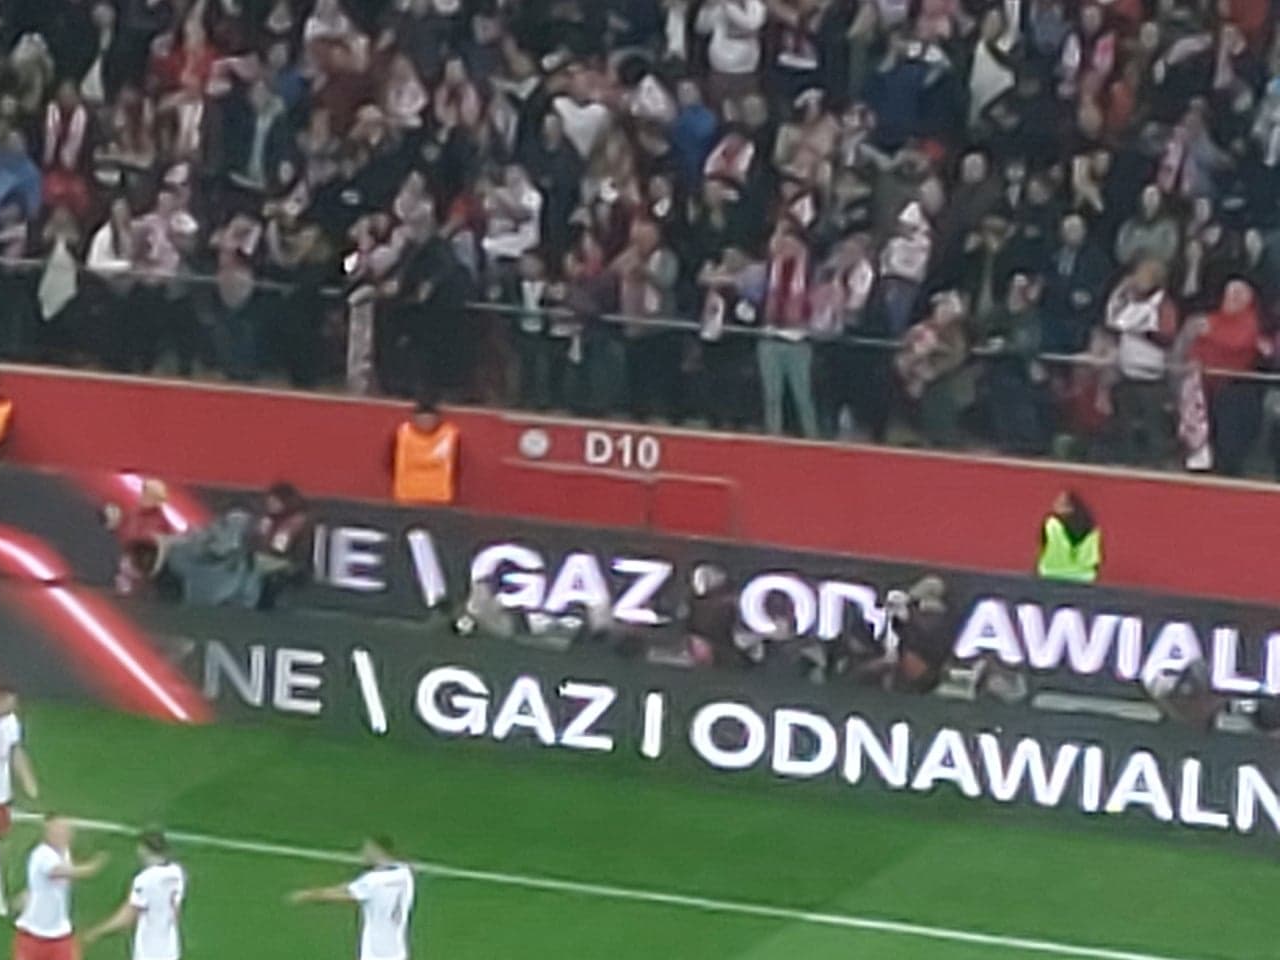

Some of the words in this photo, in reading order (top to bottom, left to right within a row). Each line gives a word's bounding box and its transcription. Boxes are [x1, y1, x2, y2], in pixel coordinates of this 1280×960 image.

[585, 430, 659, 469] D10
[314, 525, 388, 592] E
[471, 544, 674, 624] GAZ
[740, 574, 1280, 695] ODAWIAL
[417, 666, 616, 751] GAZ
[690, 702, 1280, 832] ODNAWIALN
